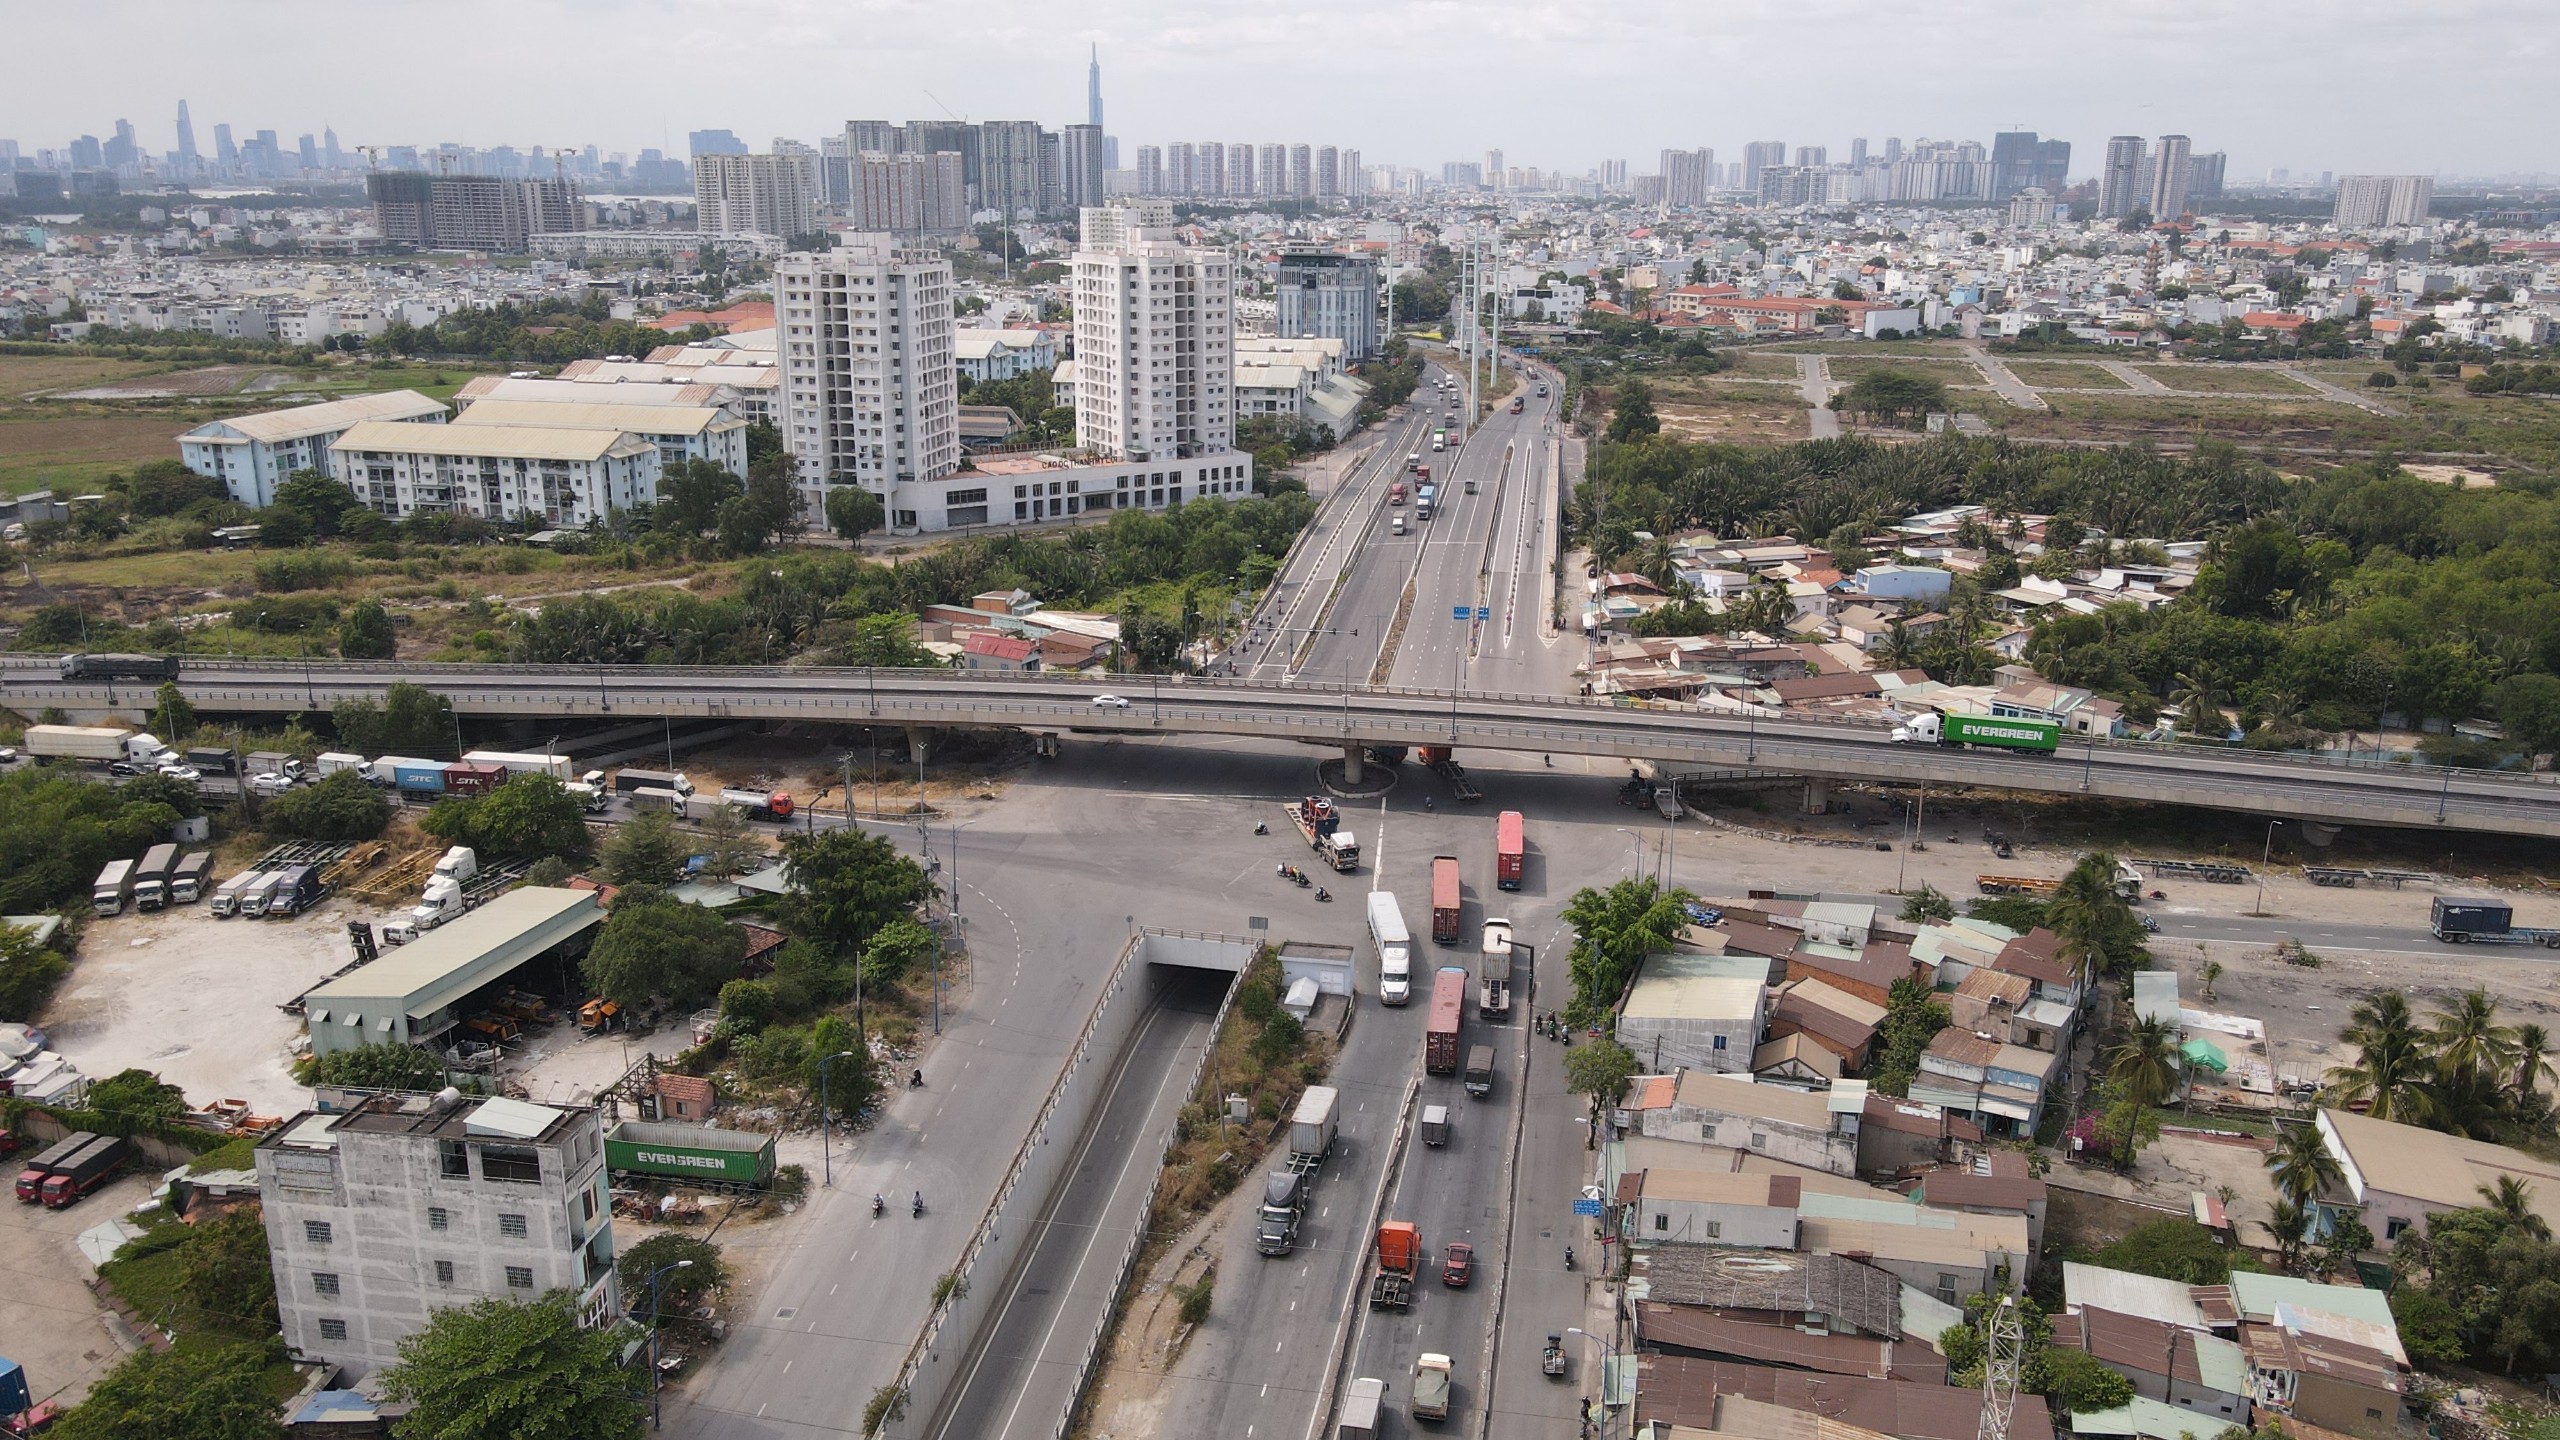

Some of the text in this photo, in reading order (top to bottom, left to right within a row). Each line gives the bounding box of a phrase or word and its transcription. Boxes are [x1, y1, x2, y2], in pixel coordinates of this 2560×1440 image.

[1961, 724, 2044, 741] EVERGREEN
[406, 775, 433, 783] SITC
[637, 1151, 726, 1169] EVERGREEN
